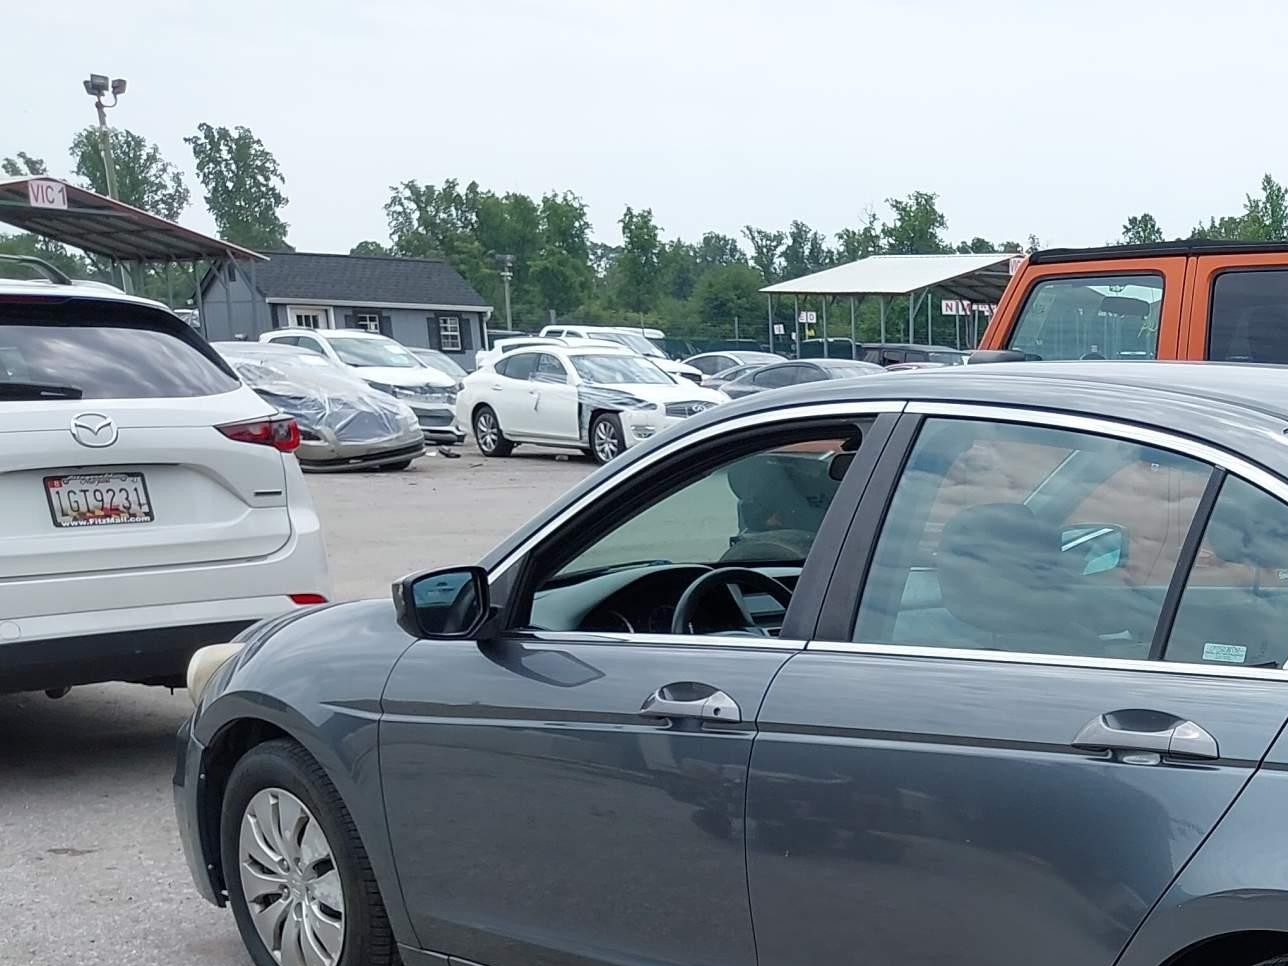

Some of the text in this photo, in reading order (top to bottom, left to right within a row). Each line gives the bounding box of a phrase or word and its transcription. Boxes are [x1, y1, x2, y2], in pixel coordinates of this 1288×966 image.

[30, 183, 66, 206] VIC 1
[55, 487, 147, 518] 1GT9231
